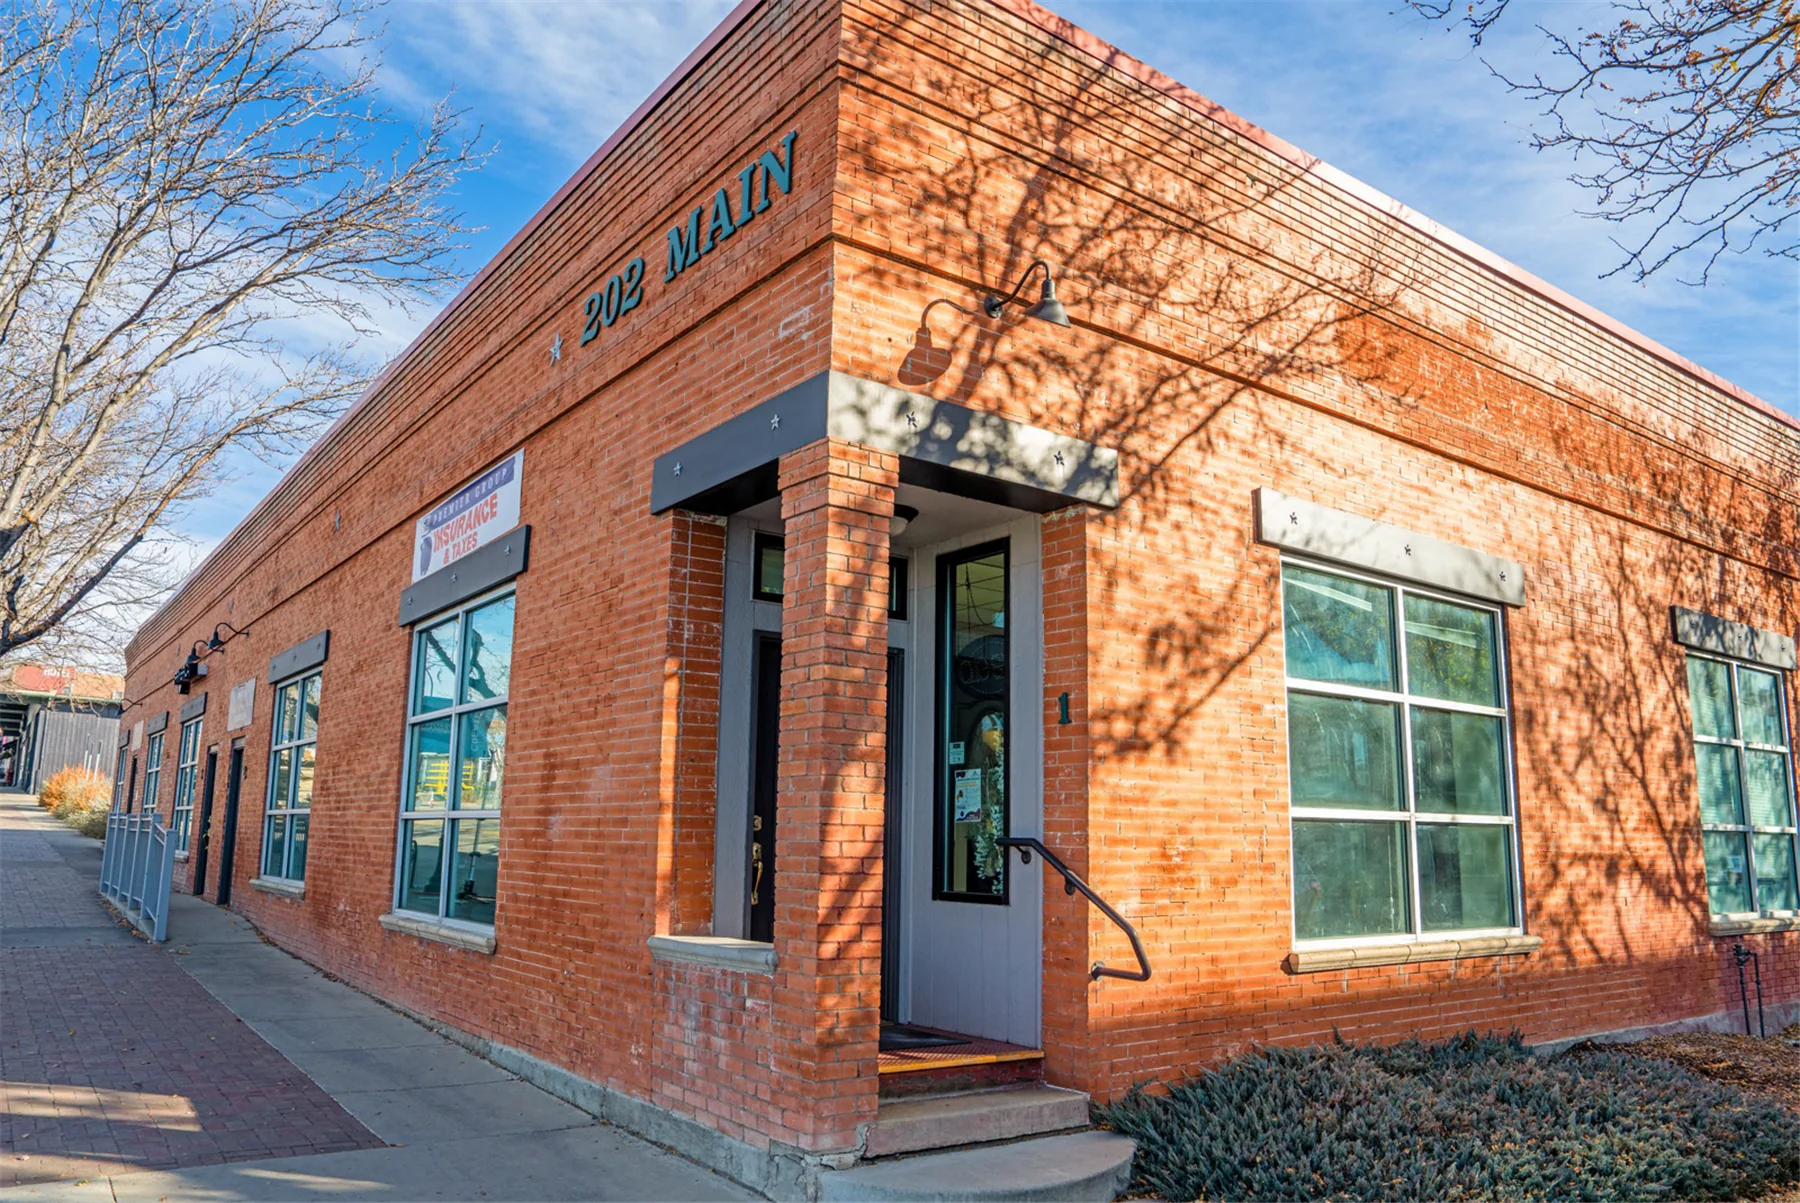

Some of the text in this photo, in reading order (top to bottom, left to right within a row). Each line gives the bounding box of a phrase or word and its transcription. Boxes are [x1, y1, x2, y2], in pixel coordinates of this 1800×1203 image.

[580, 130, 798, 347] 202 MAIN
[433, 467, 507, 525] PREMIER GROUP
[433, 492, 498, 553] INSURANCE
[443, 531, 478, 565] & TAXES
[1058, 691, 1073, 725] 1
